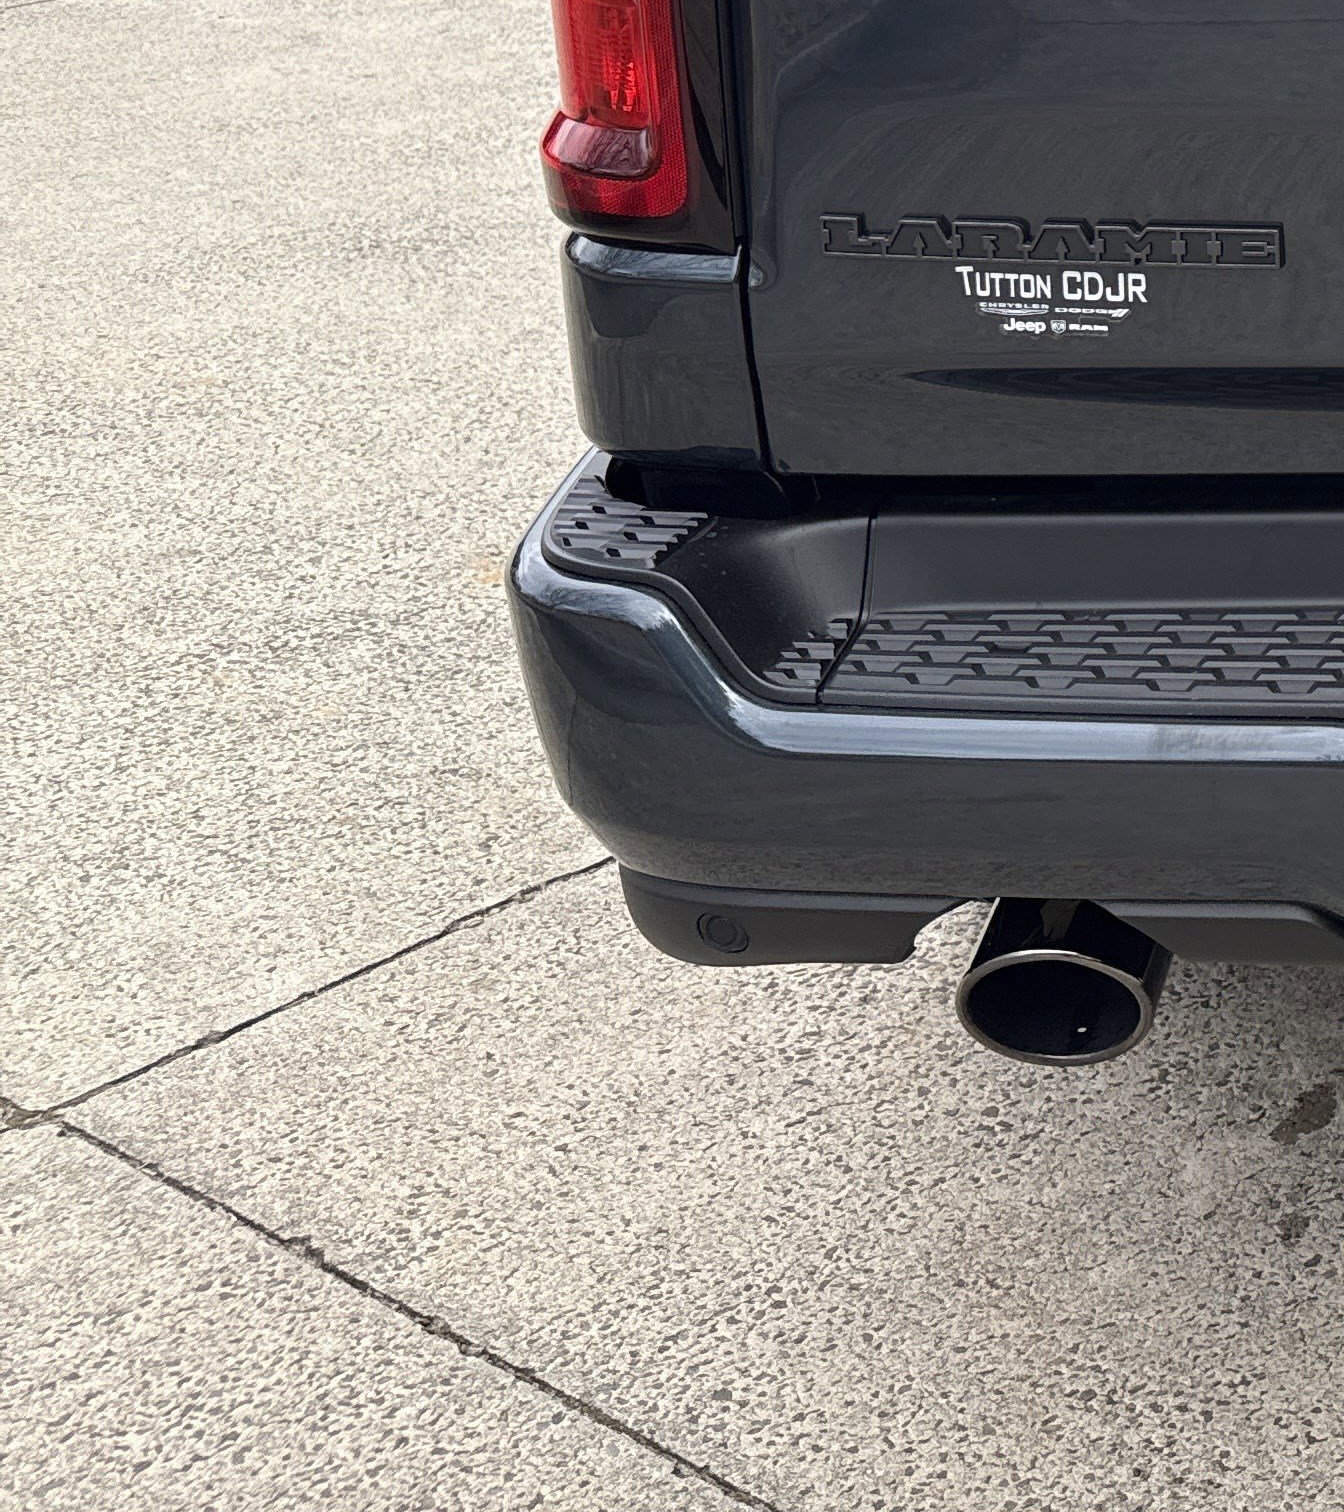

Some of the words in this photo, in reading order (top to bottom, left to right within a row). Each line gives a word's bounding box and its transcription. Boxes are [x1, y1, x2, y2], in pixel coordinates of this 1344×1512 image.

[819, 211, 1287, 270] LARAMIE
[1062, 270, 1148, 303] CDJR
[979, 301, 1050, 310] CHRYSLER
[1003, 317, 1046, 334] Jeep
